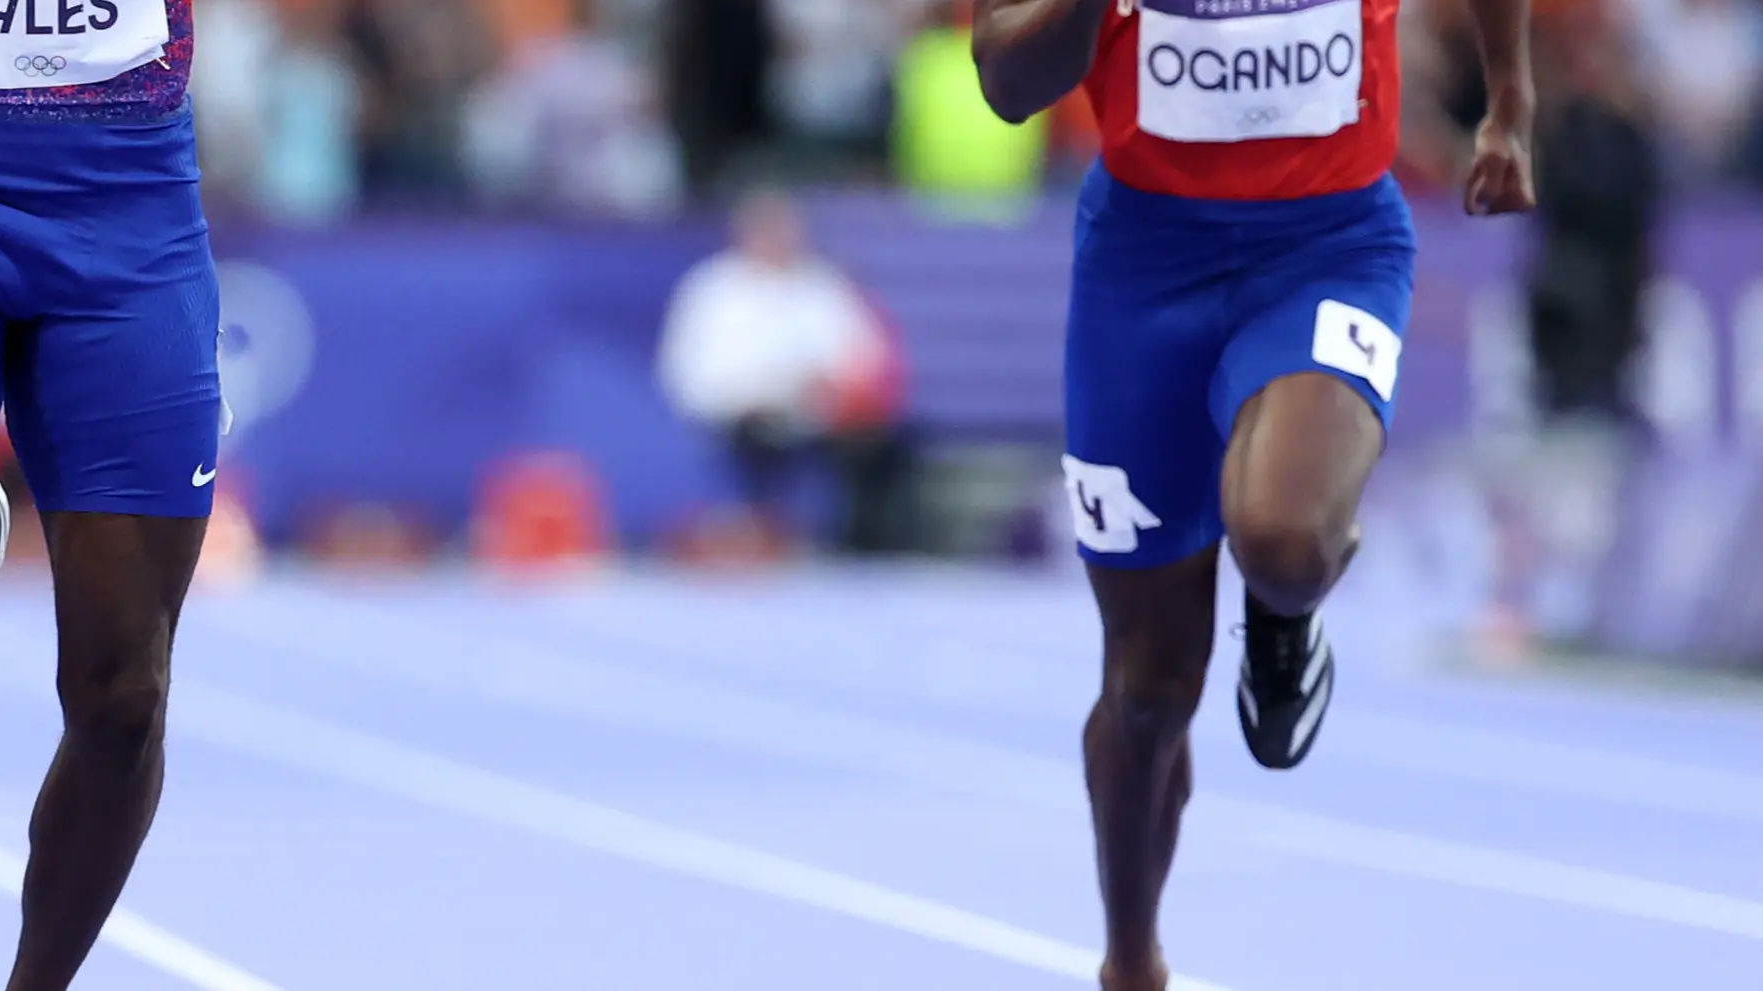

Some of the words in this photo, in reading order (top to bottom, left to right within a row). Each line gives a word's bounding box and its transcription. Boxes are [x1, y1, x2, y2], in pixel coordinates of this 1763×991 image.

[1148, 33, 1354, 93] OGANDO
[1348, 322, 1376, 367] 4
[1077, 478, 1106, 533] 4
